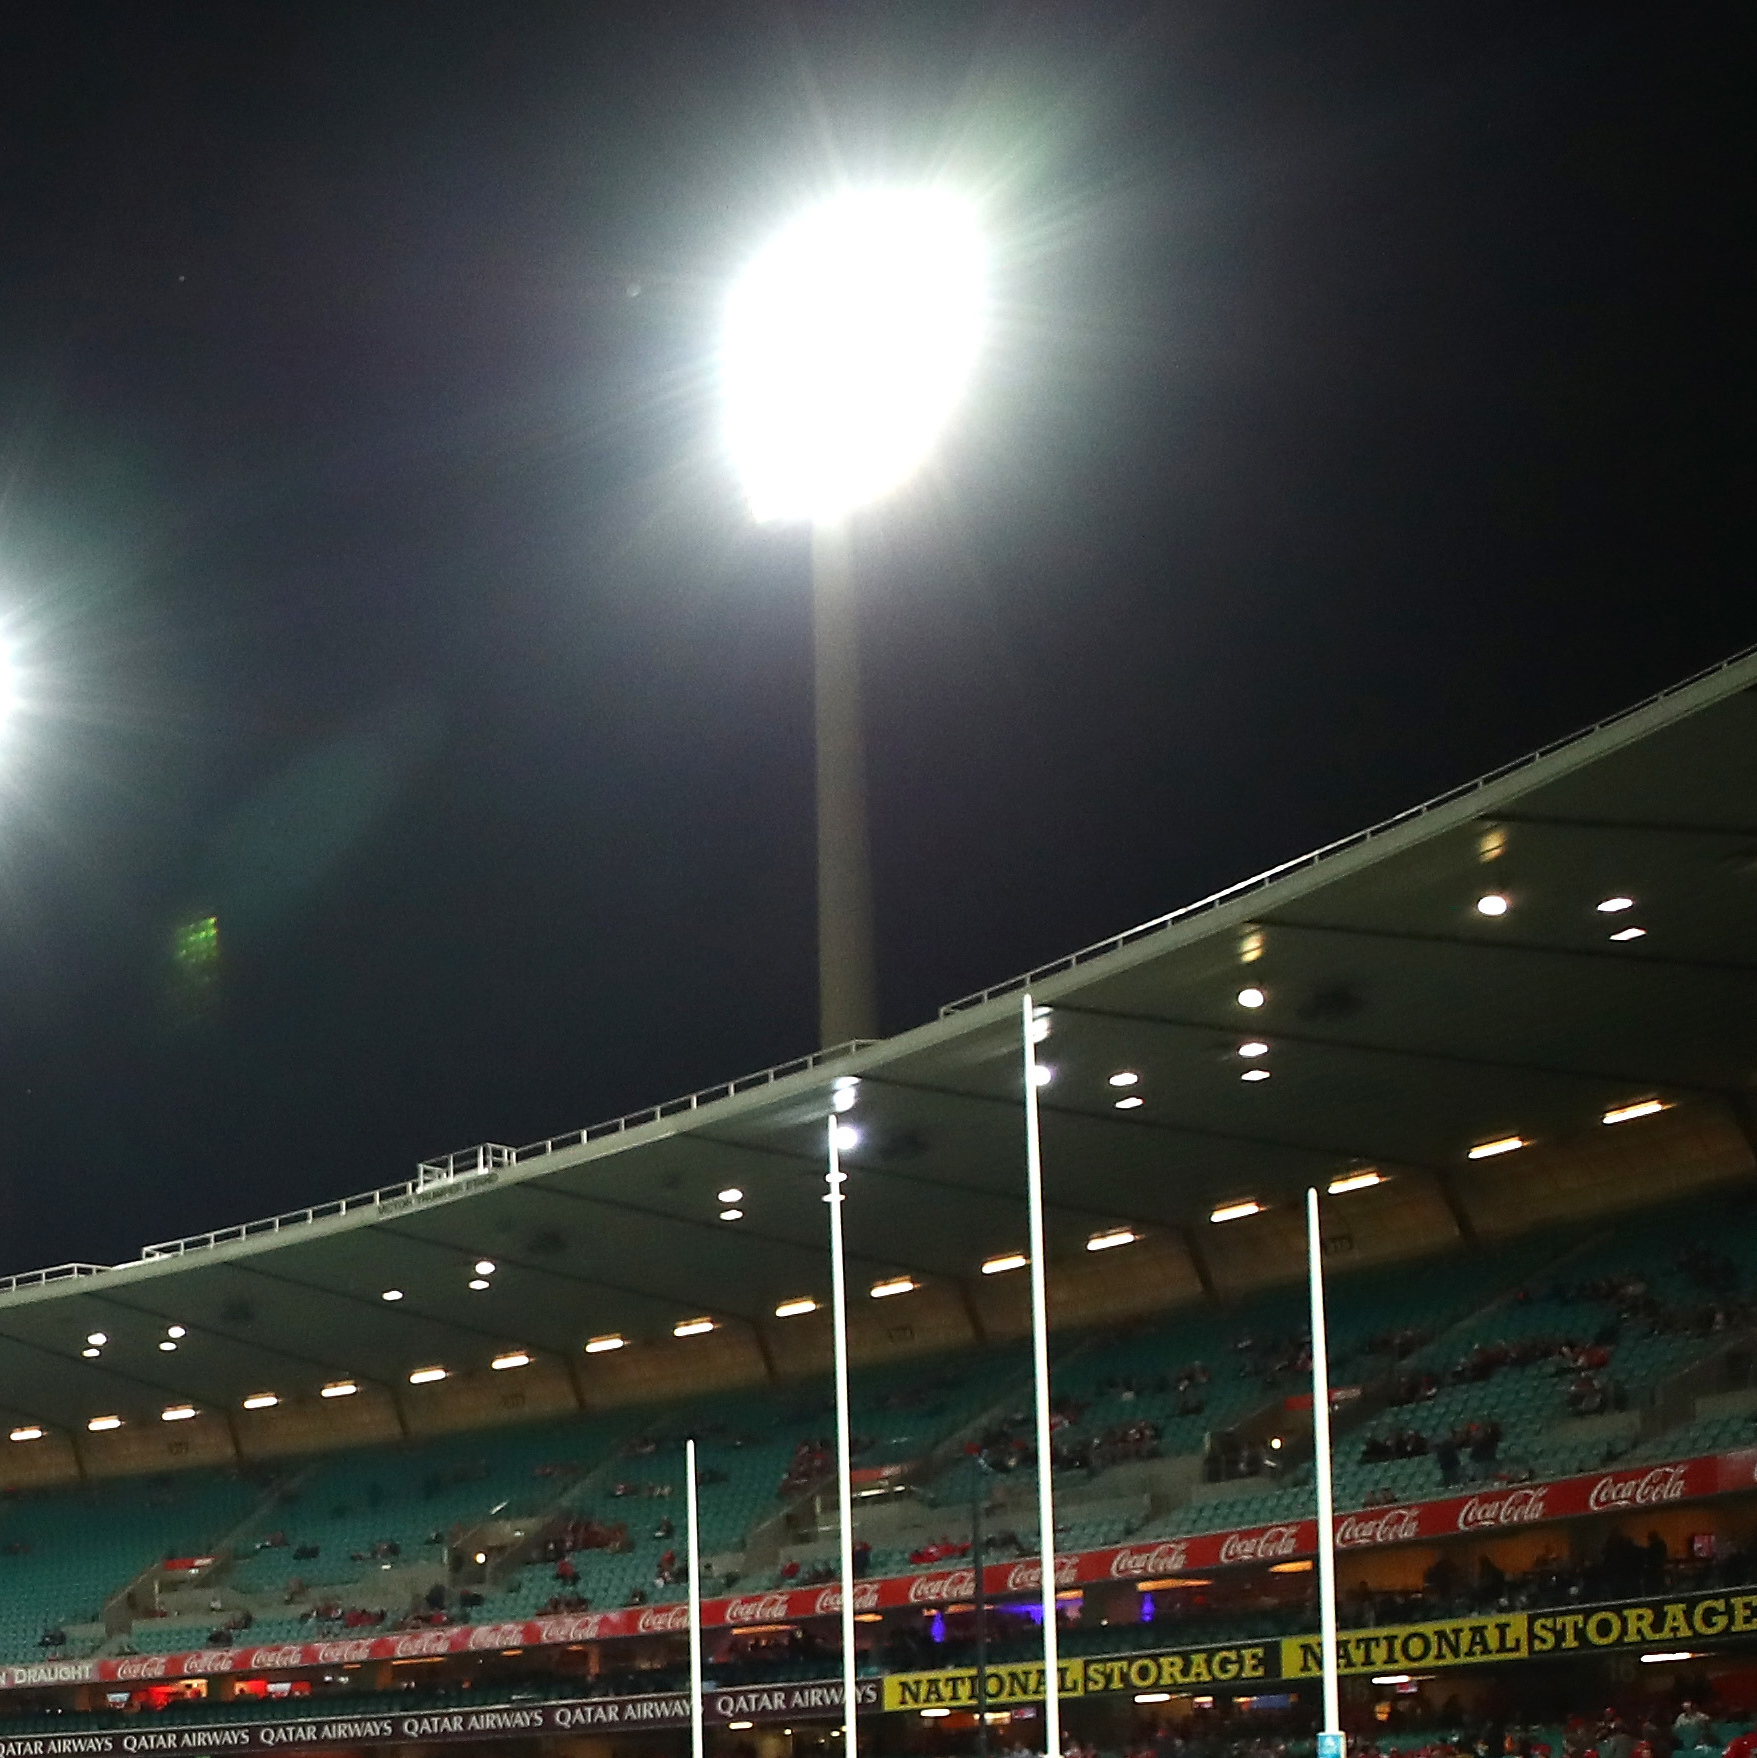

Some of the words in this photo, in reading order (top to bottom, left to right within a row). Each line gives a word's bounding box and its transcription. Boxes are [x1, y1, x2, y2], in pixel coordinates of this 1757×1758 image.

[1299, 1623, 1521, 1673] NATIONAL
[1532, 1594, 1757, 1652] STORAGE
[14, 1666, 91, 1685] DRAUGHT
[1085, 1647, 1264, 1691] STORAGE
[554, 1705, 618, 1725] QATAR
[624, 1699, 702, 1720] AIRWAY
[716, 1694, 785, 1717] QATAR
[791, 1685, 877, 1708] AIRWYS
[260, 1727, 316, 1745] QATAR
[321, 1720, 392, 1739] AIRWAYS
[402, 1717, 462, 1737] QATAR
[468, 1709, 543, 1730] AIRWAYS
[47, 1737, 112, 1754] AIRWAYS
[123, 1735, 176, 1753] QATAR
[181, 1729, 249, 1747] AIRWAYS
